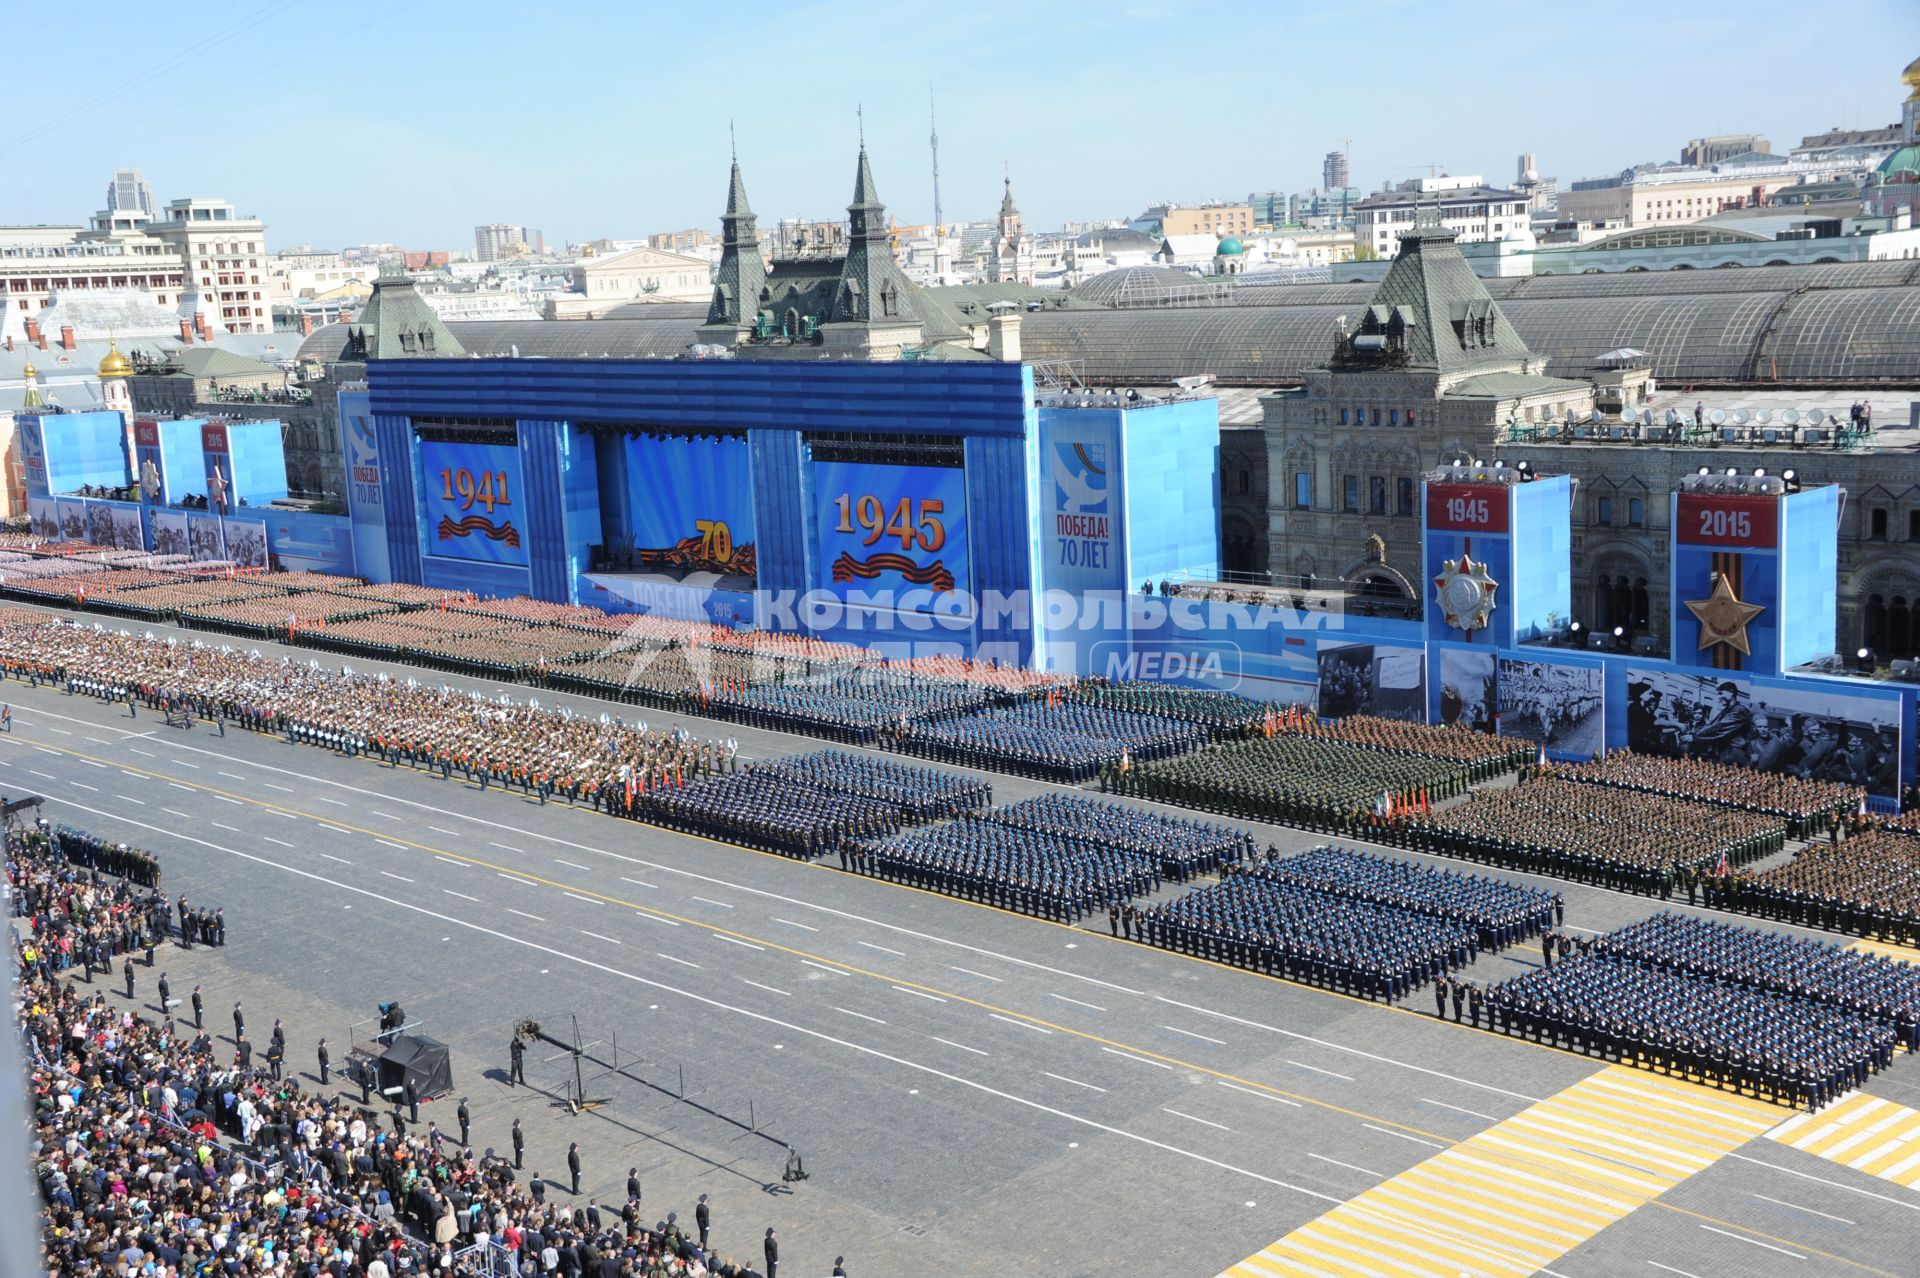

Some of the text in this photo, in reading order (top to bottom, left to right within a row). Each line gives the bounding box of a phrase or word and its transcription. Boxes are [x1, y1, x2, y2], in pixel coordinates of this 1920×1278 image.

[140, 428, 153, 440] 1945
[208, 433, 223, 447] 2015
[355, 483, 367, 504] 70
[441, 467, 512, 514] 1941
[834, 493, 946, 553] 1945
[1446, 498, 1489, 524] 1945
[1700, 510, 1751, 538] 2015
[1057, 514, 1108, 539] ПОБЕДА!
[695, 519, 732, 563] 70
[1057, 538, 1108, 569] 70 ЛЕТ
[713, 602, 734, 618] 2015
